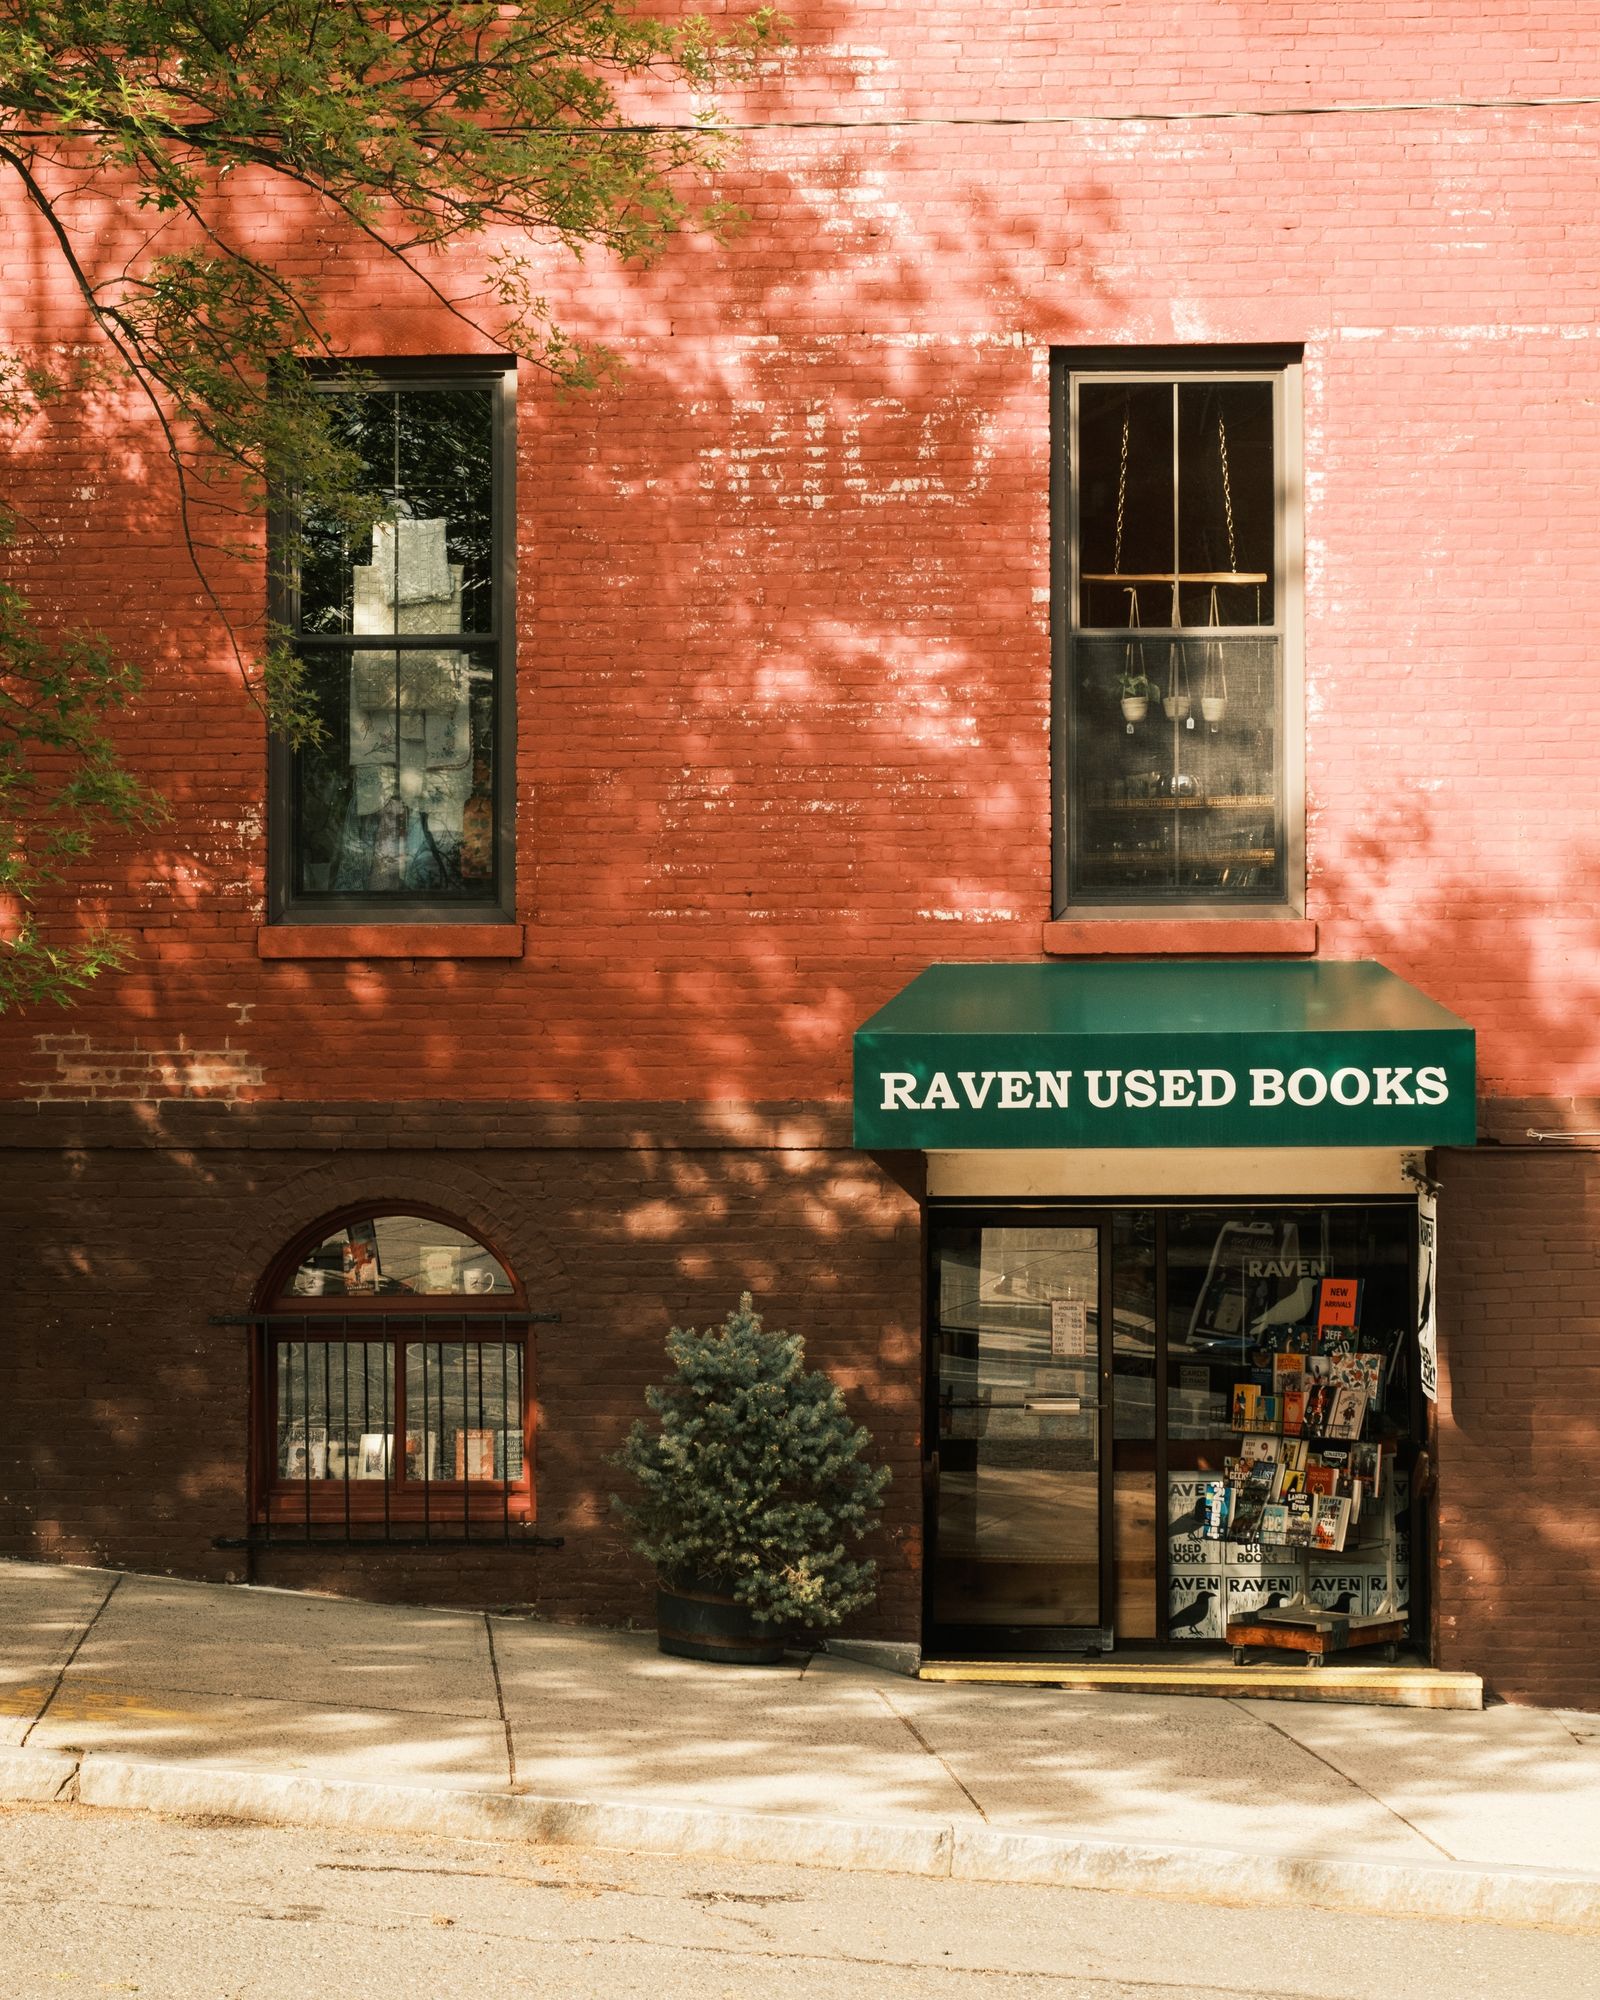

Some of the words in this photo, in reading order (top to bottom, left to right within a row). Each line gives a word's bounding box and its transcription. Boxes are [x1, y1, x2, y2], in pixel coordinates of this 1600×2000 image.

[880, 1070, 1072, 1110] RAVEN
[1084, 1068, 1236, 1108] USED
[1249, 1066, 1449, 1106] BOOKS
[1249, 1260, 1326, 1278] RAVEN
[1330, 1288, 1349, 1297] NEW
[1325, 1330, 1342, 1340] JEFF
[1169, 1484, 1206, 1496] AVE
[1287, 1494, 1308, 1502] LAMENT
[1173, 1543, 1202, 1553] USED
[1245, 1543, 1273, 1553] USED
[1236, 1552, 1278, 1563] BOOKS
[1169, 1577, 1219, 1591] AVEN
[1229, 1577, 1291, 1592] RAVEN
[1311, 1578, 1359, 1591] AVEN
